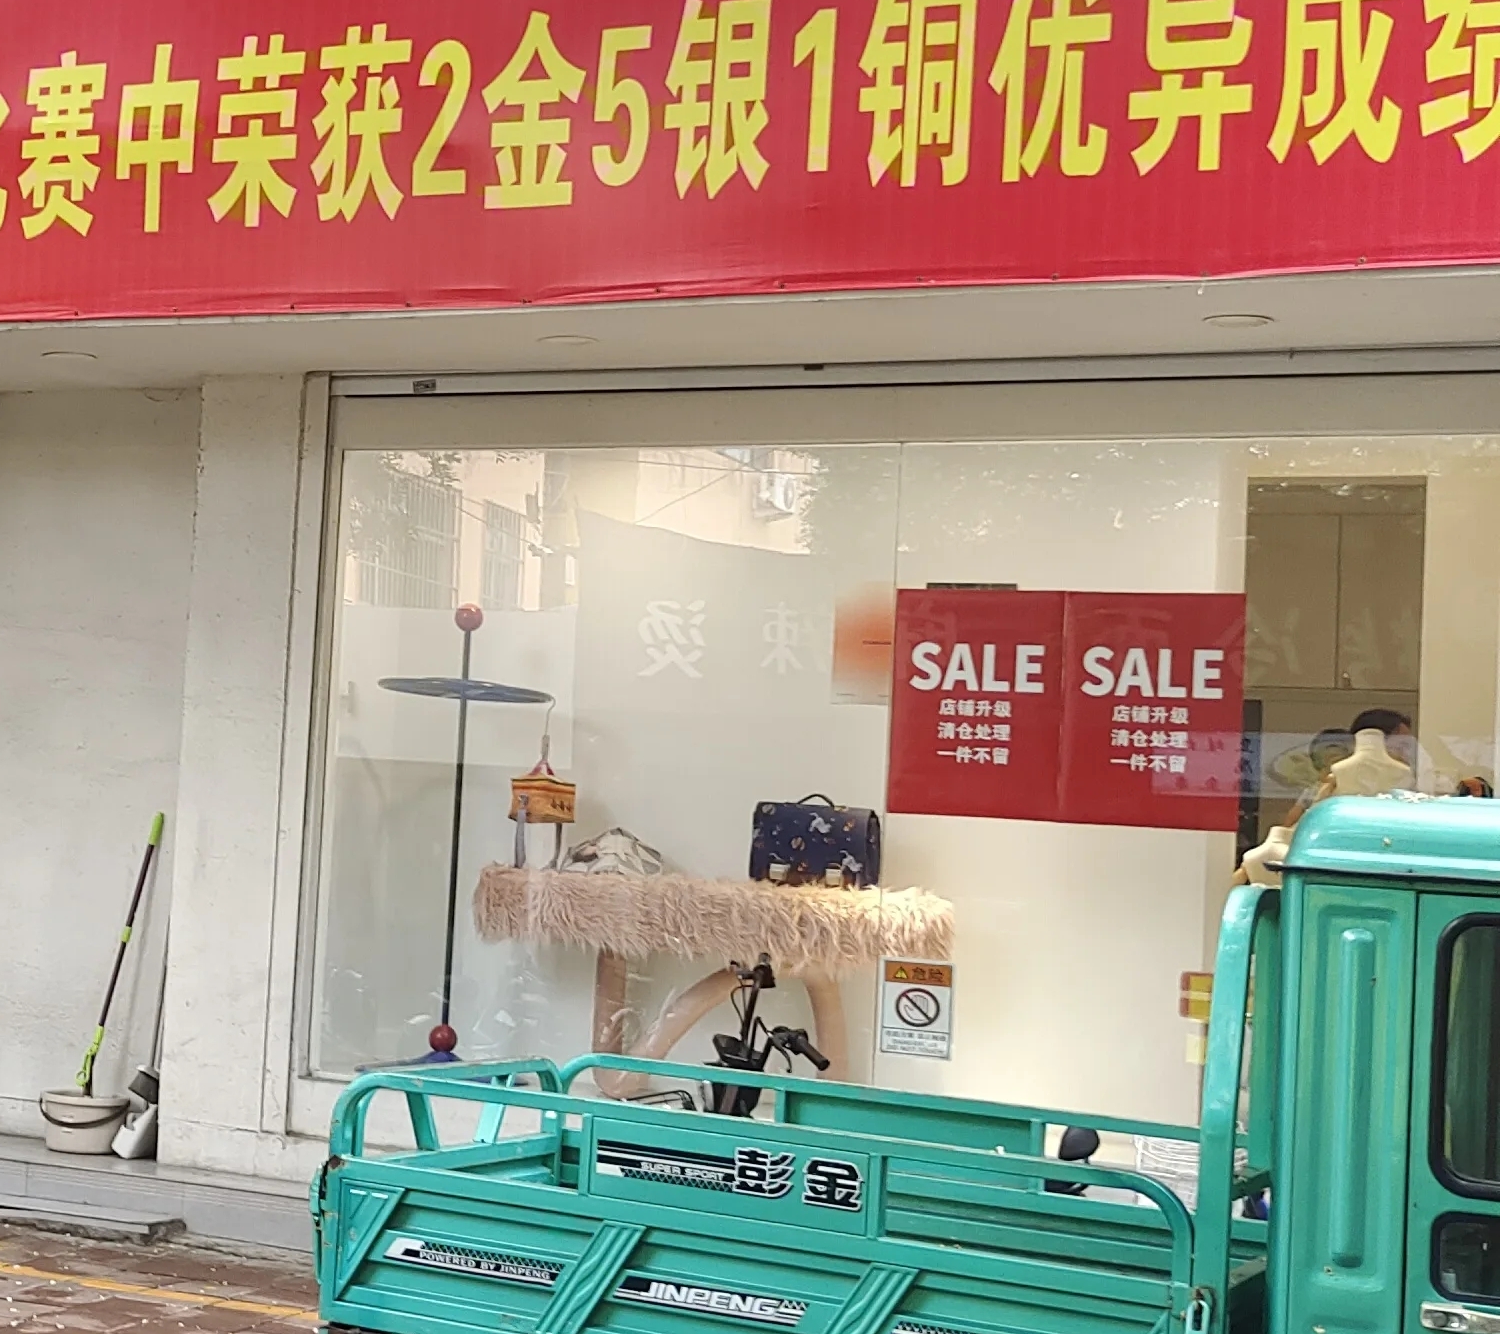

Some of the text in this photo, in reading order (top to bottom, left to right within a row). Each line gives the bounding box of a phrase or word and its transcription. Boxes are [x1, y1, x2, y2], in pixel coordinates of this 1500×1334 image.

[909, 641, 1046, 694] SALE
[1080, 646, 1224, 699] SALE
[939, 698, 1011, 718] 店铺升级
[1112, 705, 1189, 725] 店铺升级
[937, 721, 1011, 741] 清仓处理
[1111, 729, 1188, 748] 清仓处理
[936, 746, 1010, 765] 一件不留
[1110, 754, 1187, 773] 一件不留
[640, 1161, 725, 1182] SUPER SPORT
[418, 1251, 551, 1281] POWERED BY JINPENG
[644, 1281, 781, 1316] JINPENG
